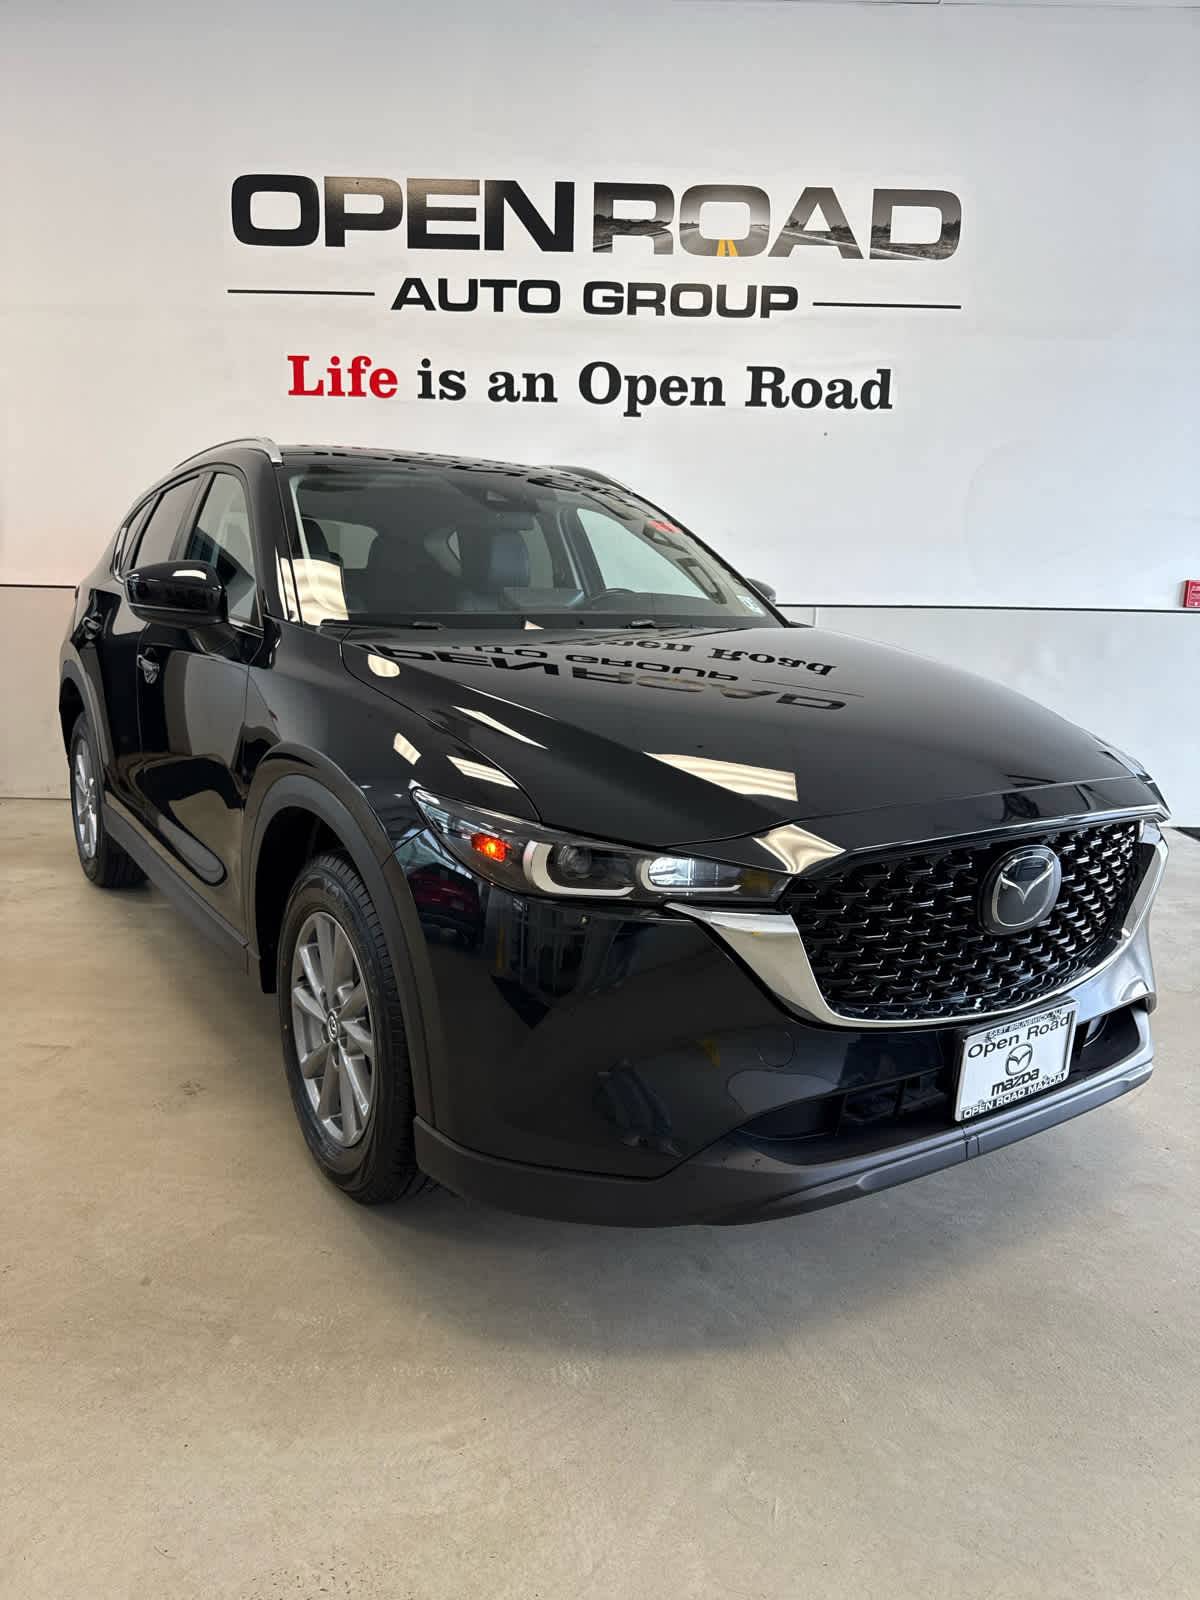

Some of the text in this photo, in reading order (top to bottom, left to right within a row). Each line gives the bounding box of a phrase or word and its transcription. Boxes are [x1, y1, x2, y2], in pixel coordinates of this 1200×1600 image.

[230, 173, 962, 261] OPEN ROAD
[391, 277, 799, 319] AUTO GROUP
[287, 355, 893, 418] Life is an Open Road
[967, 1034, 1020, 1059] Open
[1026, 1014, 1070, 1040] Road
[963, 1101, 994, 1119] OPEN
[996, 1088, 1026, 1107] ROAD
